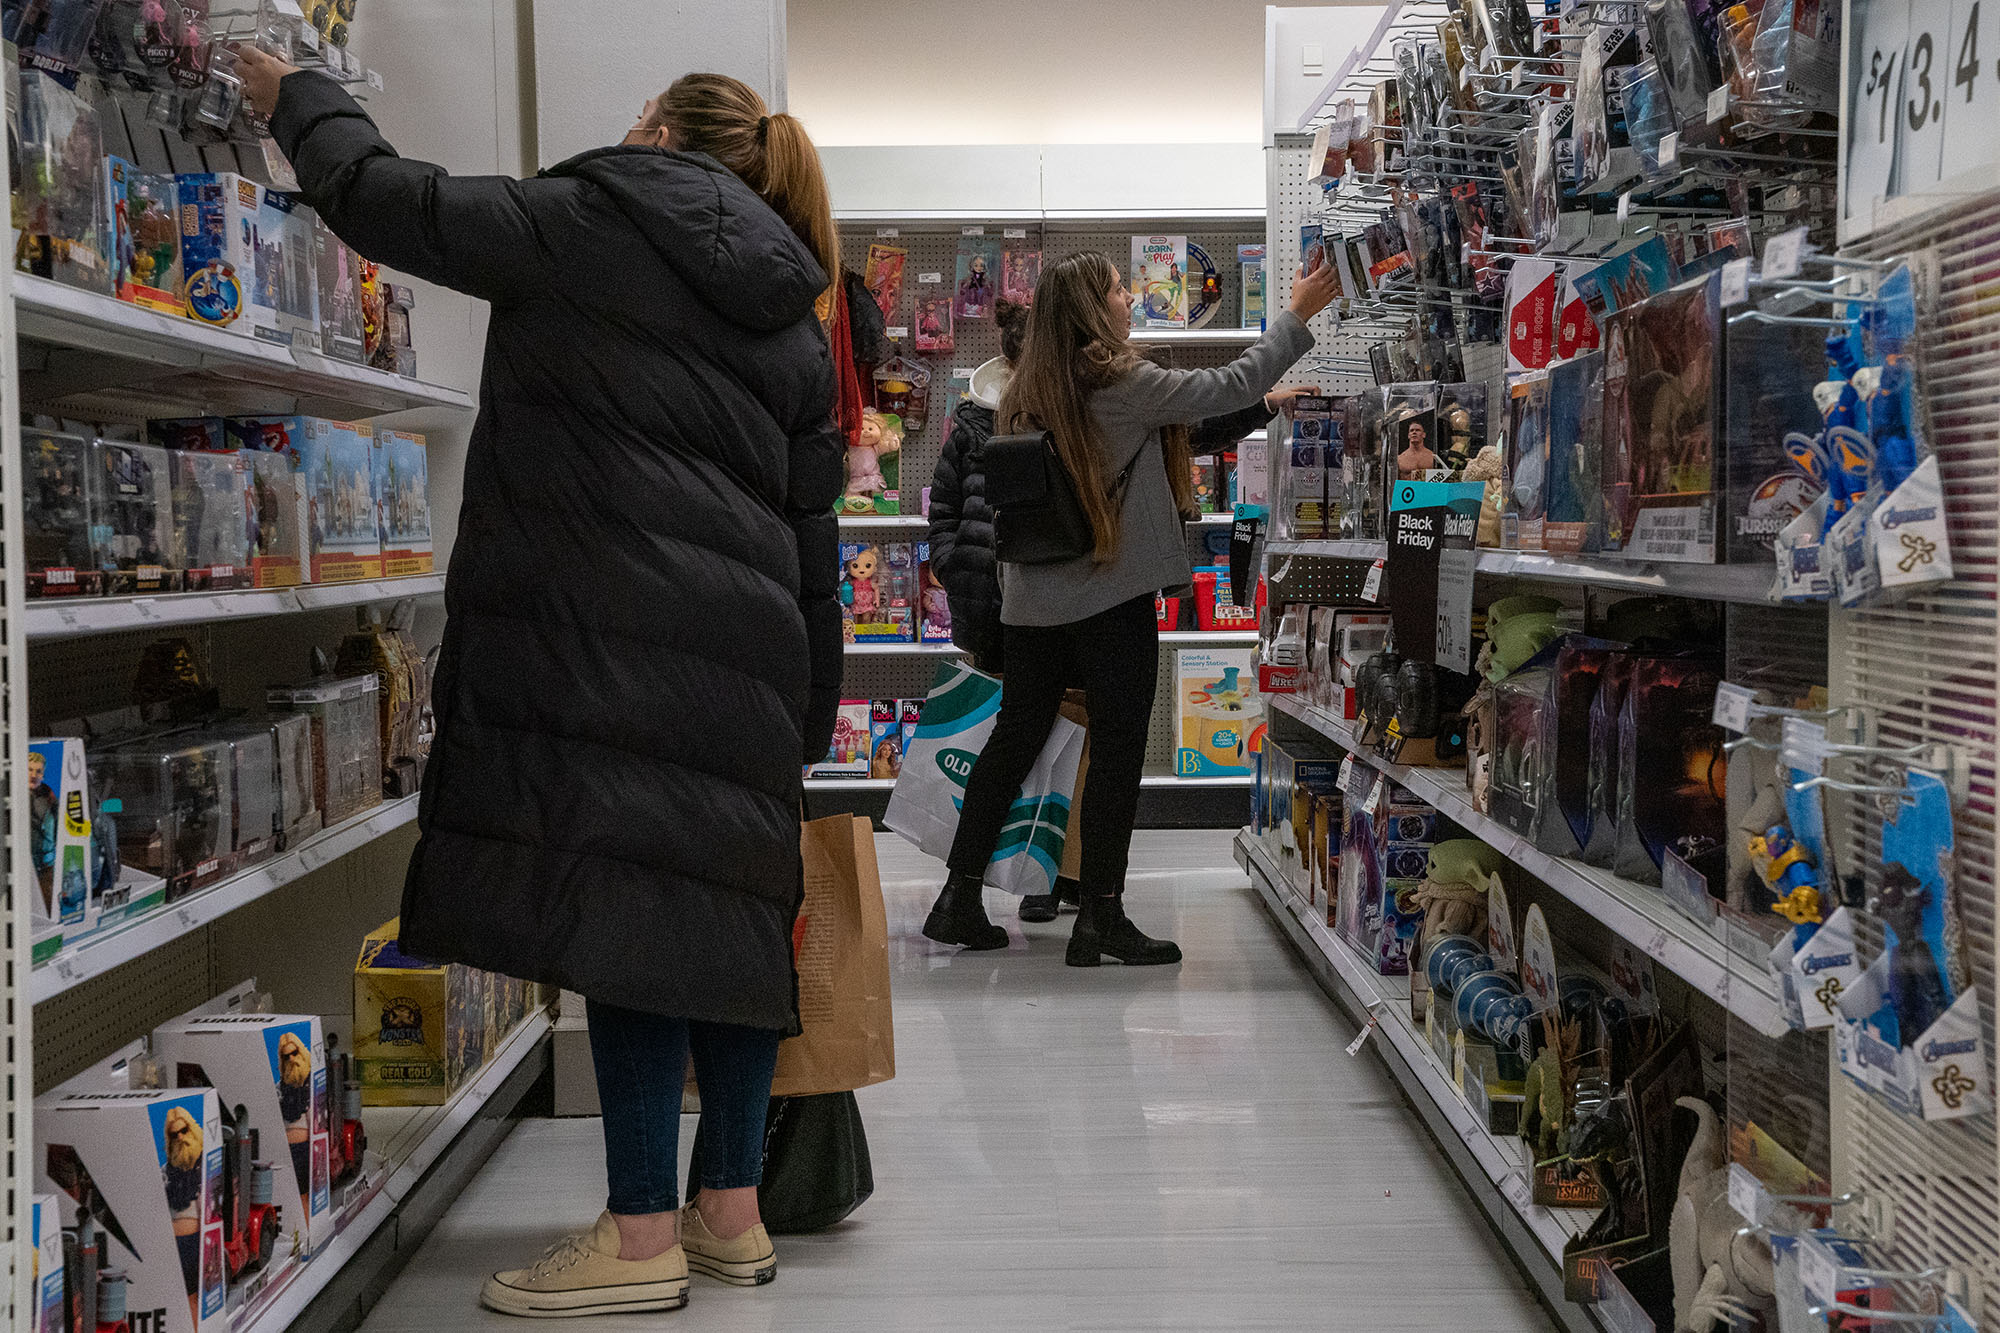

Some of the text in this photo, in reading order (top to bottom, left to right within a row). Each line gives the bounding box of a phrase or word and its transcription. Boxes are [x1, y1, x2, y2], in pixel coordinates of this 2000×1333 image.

[1603, 28, 1622, 48] STAR
[1603, 29, 1625, 53] WARS
[1867, 1, 2000, 144] $13.4
[1554, 103, 1573, 122] STAR
[1554, 106, 1574, 127] WARS
[1236, 522, 1251, 533] Black
[1400, 513, 1432, 531] Black
[1444, 513, 1475, 541] Black Friday
[1234, 532, 1252, 543] Friday
[1397, 530, 1434, 550] Friday
[873, 703, 888, 713] my
[903, 703, 918, 714] my
[944, 753, 971, 777] OLD
[188, 1017, 276, 1025] FORTNITE
[381, 1067, 432, 1079] REAL GOLD
[64, 1091, 164, 1100] FORTNITE
[1556, 1185, 1598, 1201] ESCAPE
